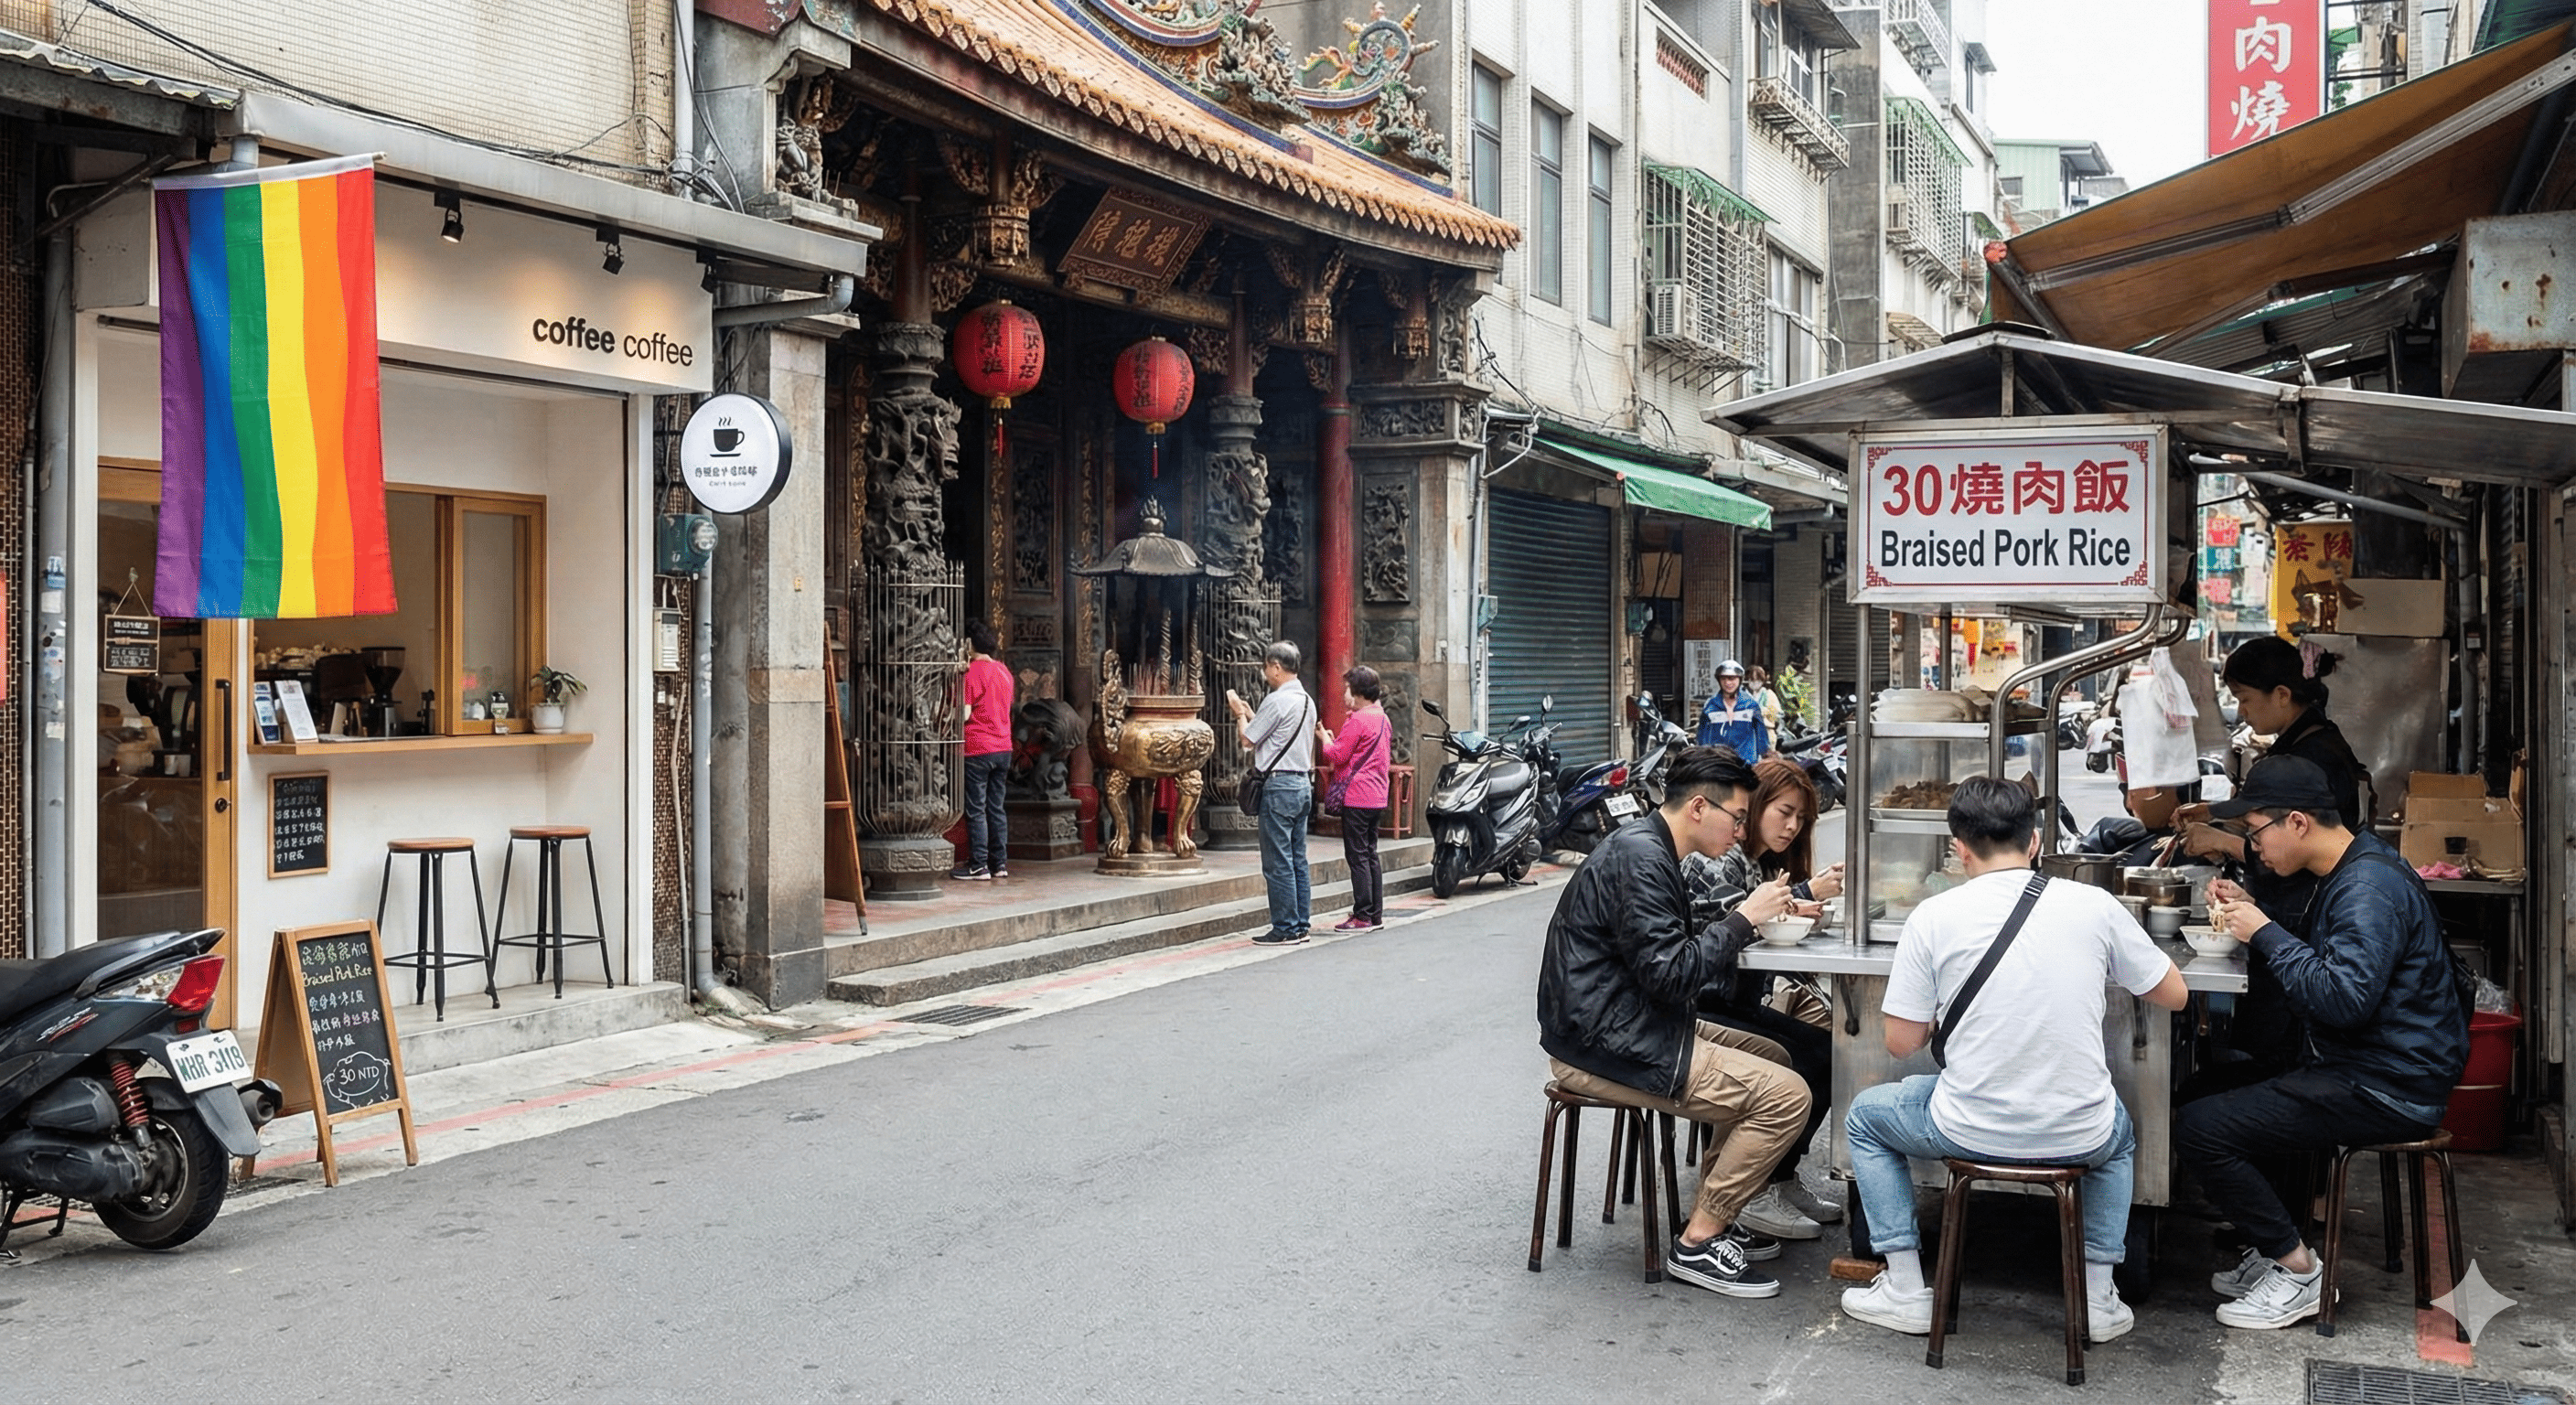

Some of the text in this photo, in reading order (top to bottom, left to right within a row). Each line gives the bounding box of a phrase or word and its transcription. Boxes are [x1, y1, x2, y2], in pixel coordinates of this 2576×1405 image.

[2230, 0, 2292, 140] 肉燒
[532, 316, 693, 367] coffee coffee
[1881, 527, 2131, 567] Braised Pork Rice
[338, 1065, 380, 1086] 30 NTD
